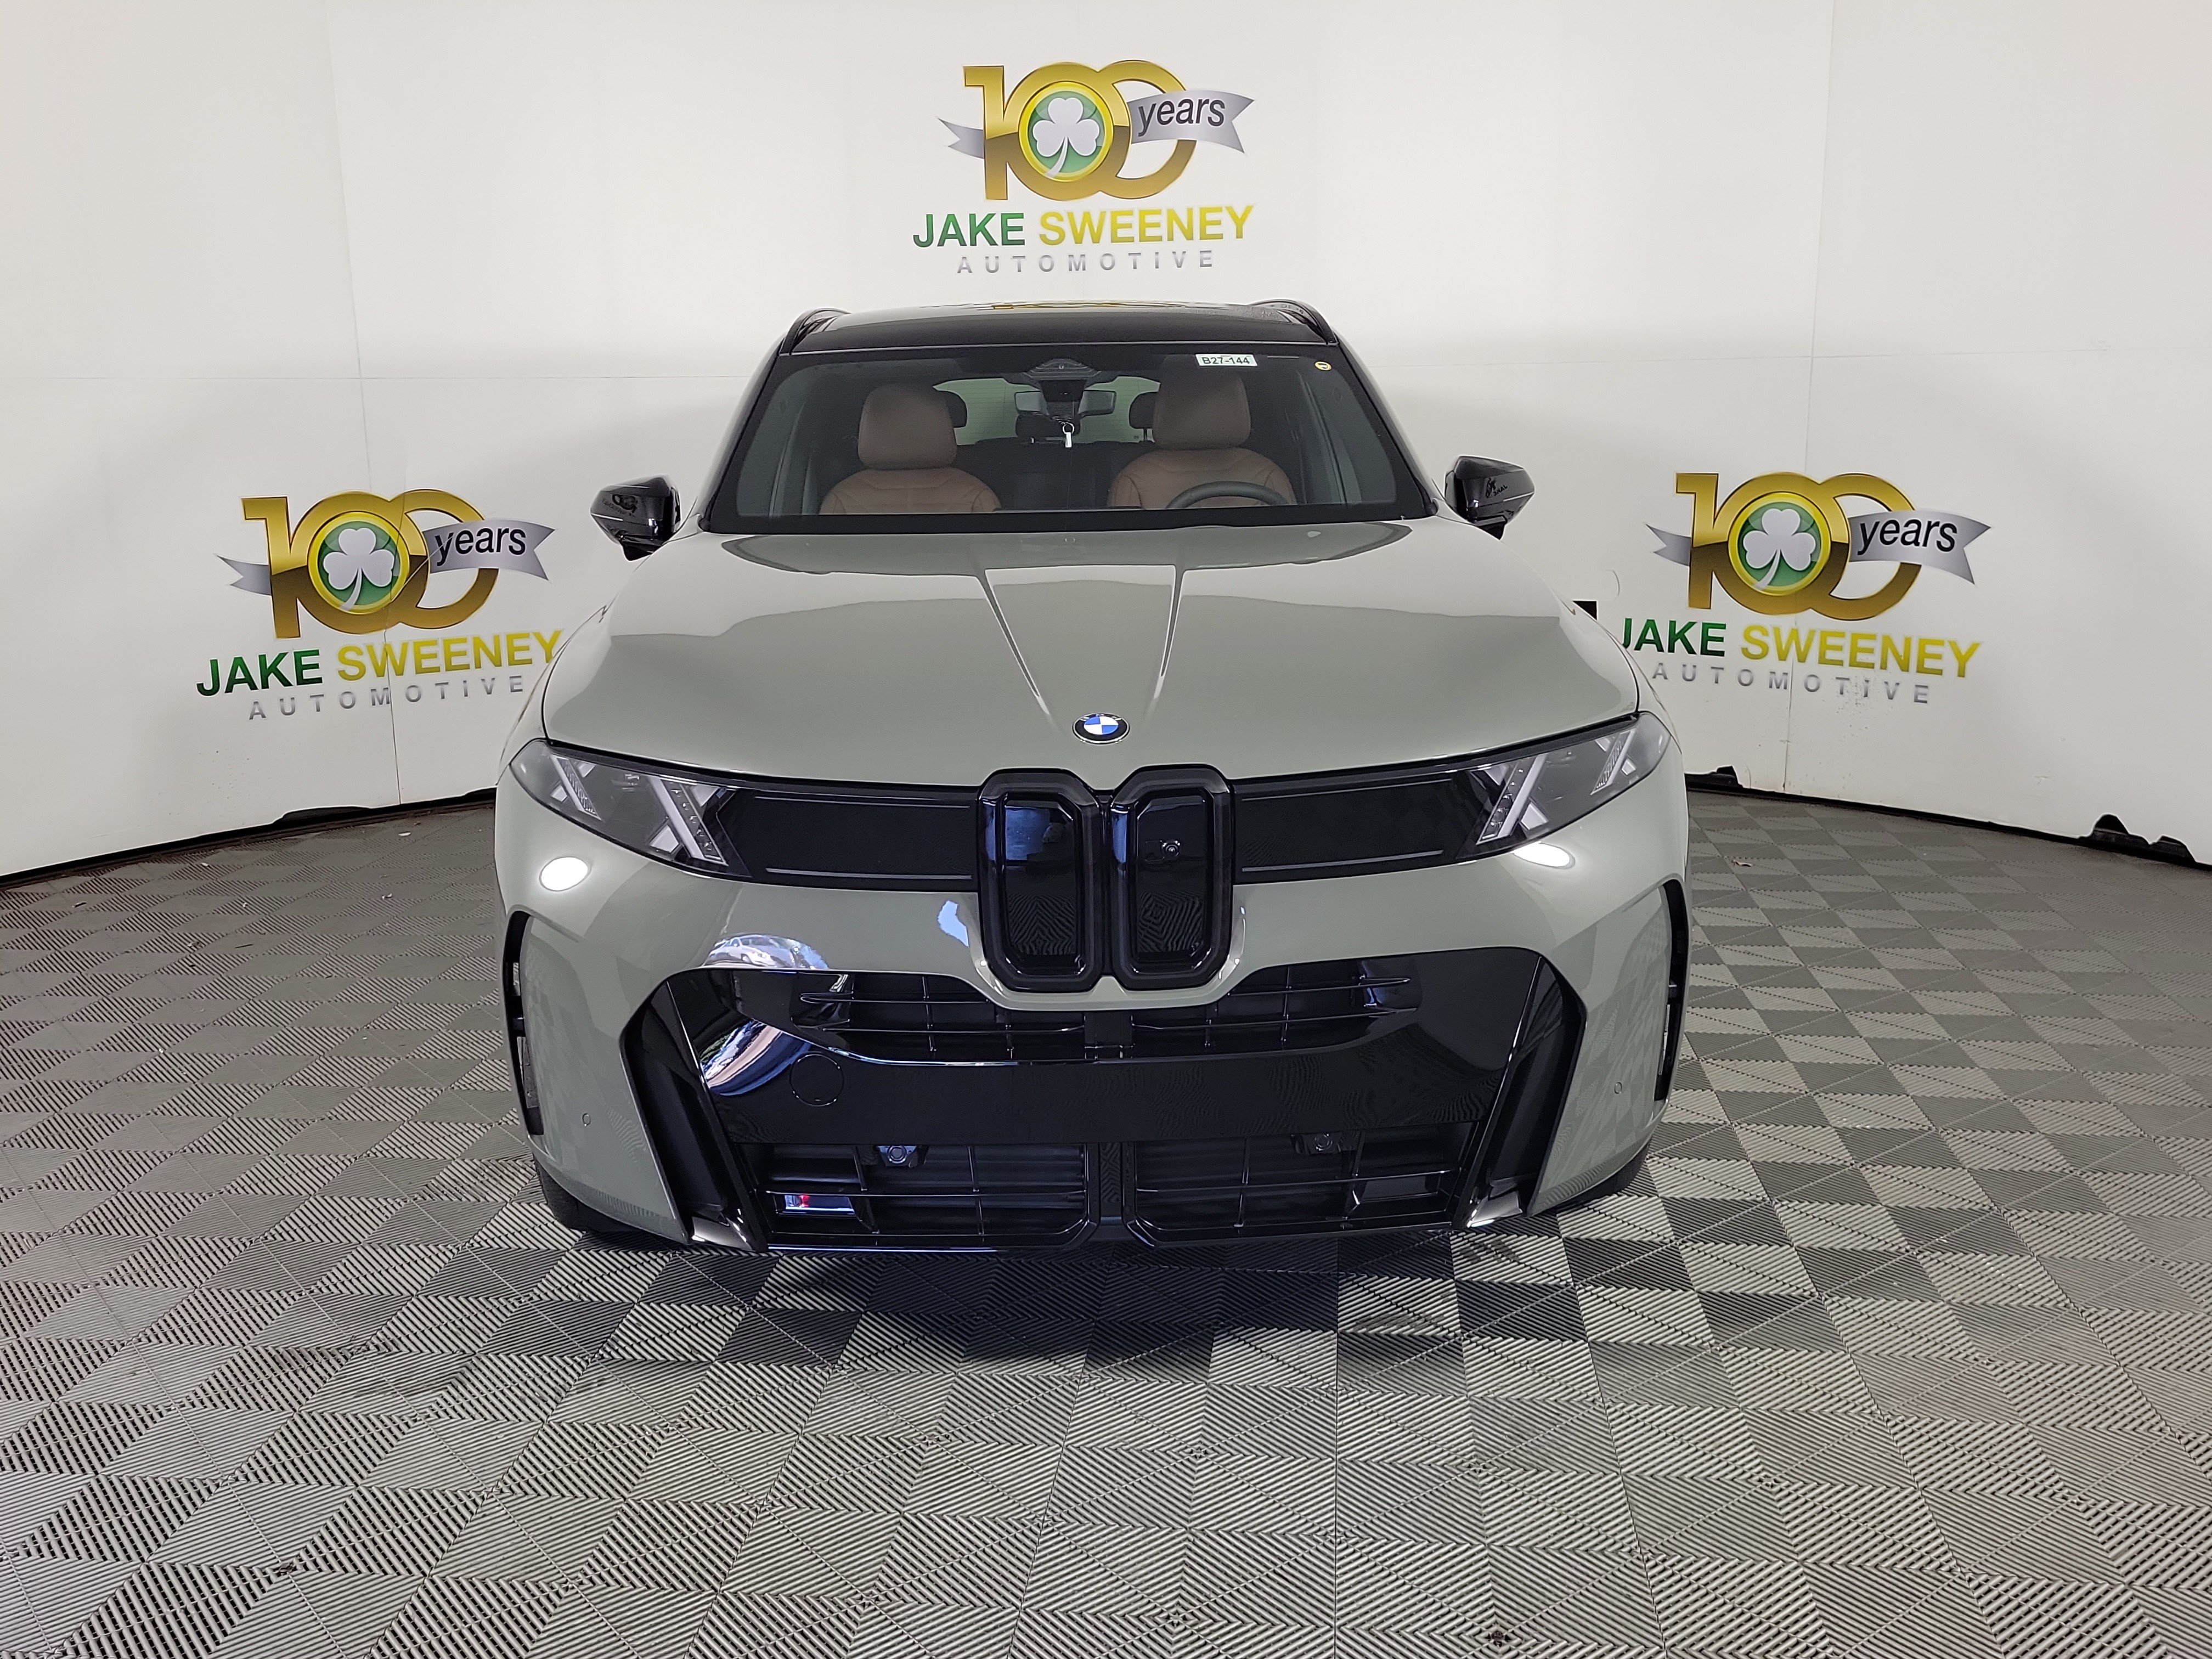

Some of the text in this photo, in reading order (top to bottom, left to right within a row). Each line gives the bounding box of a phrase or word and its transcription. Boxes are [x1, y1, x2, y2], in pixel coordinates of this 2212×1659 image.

[963, 60, 1226, 201] 100 years
[913, 205, 1254, 247] JAKE SWEENEY
[957, 250, 1212, 274] AUTOMOTIVE
[241, 489, 527, 639] 100 years
[1675, 471, 1959, 621] 100 years
[196, 630, 563, 697] JAKE SWEENEY
[1741, 625, 1980, 678] SWEENEY
[249, 675, 523, 720] AUTOMOTIVE
[1652, 662, 1929, 704] AUTOMOTIVE
